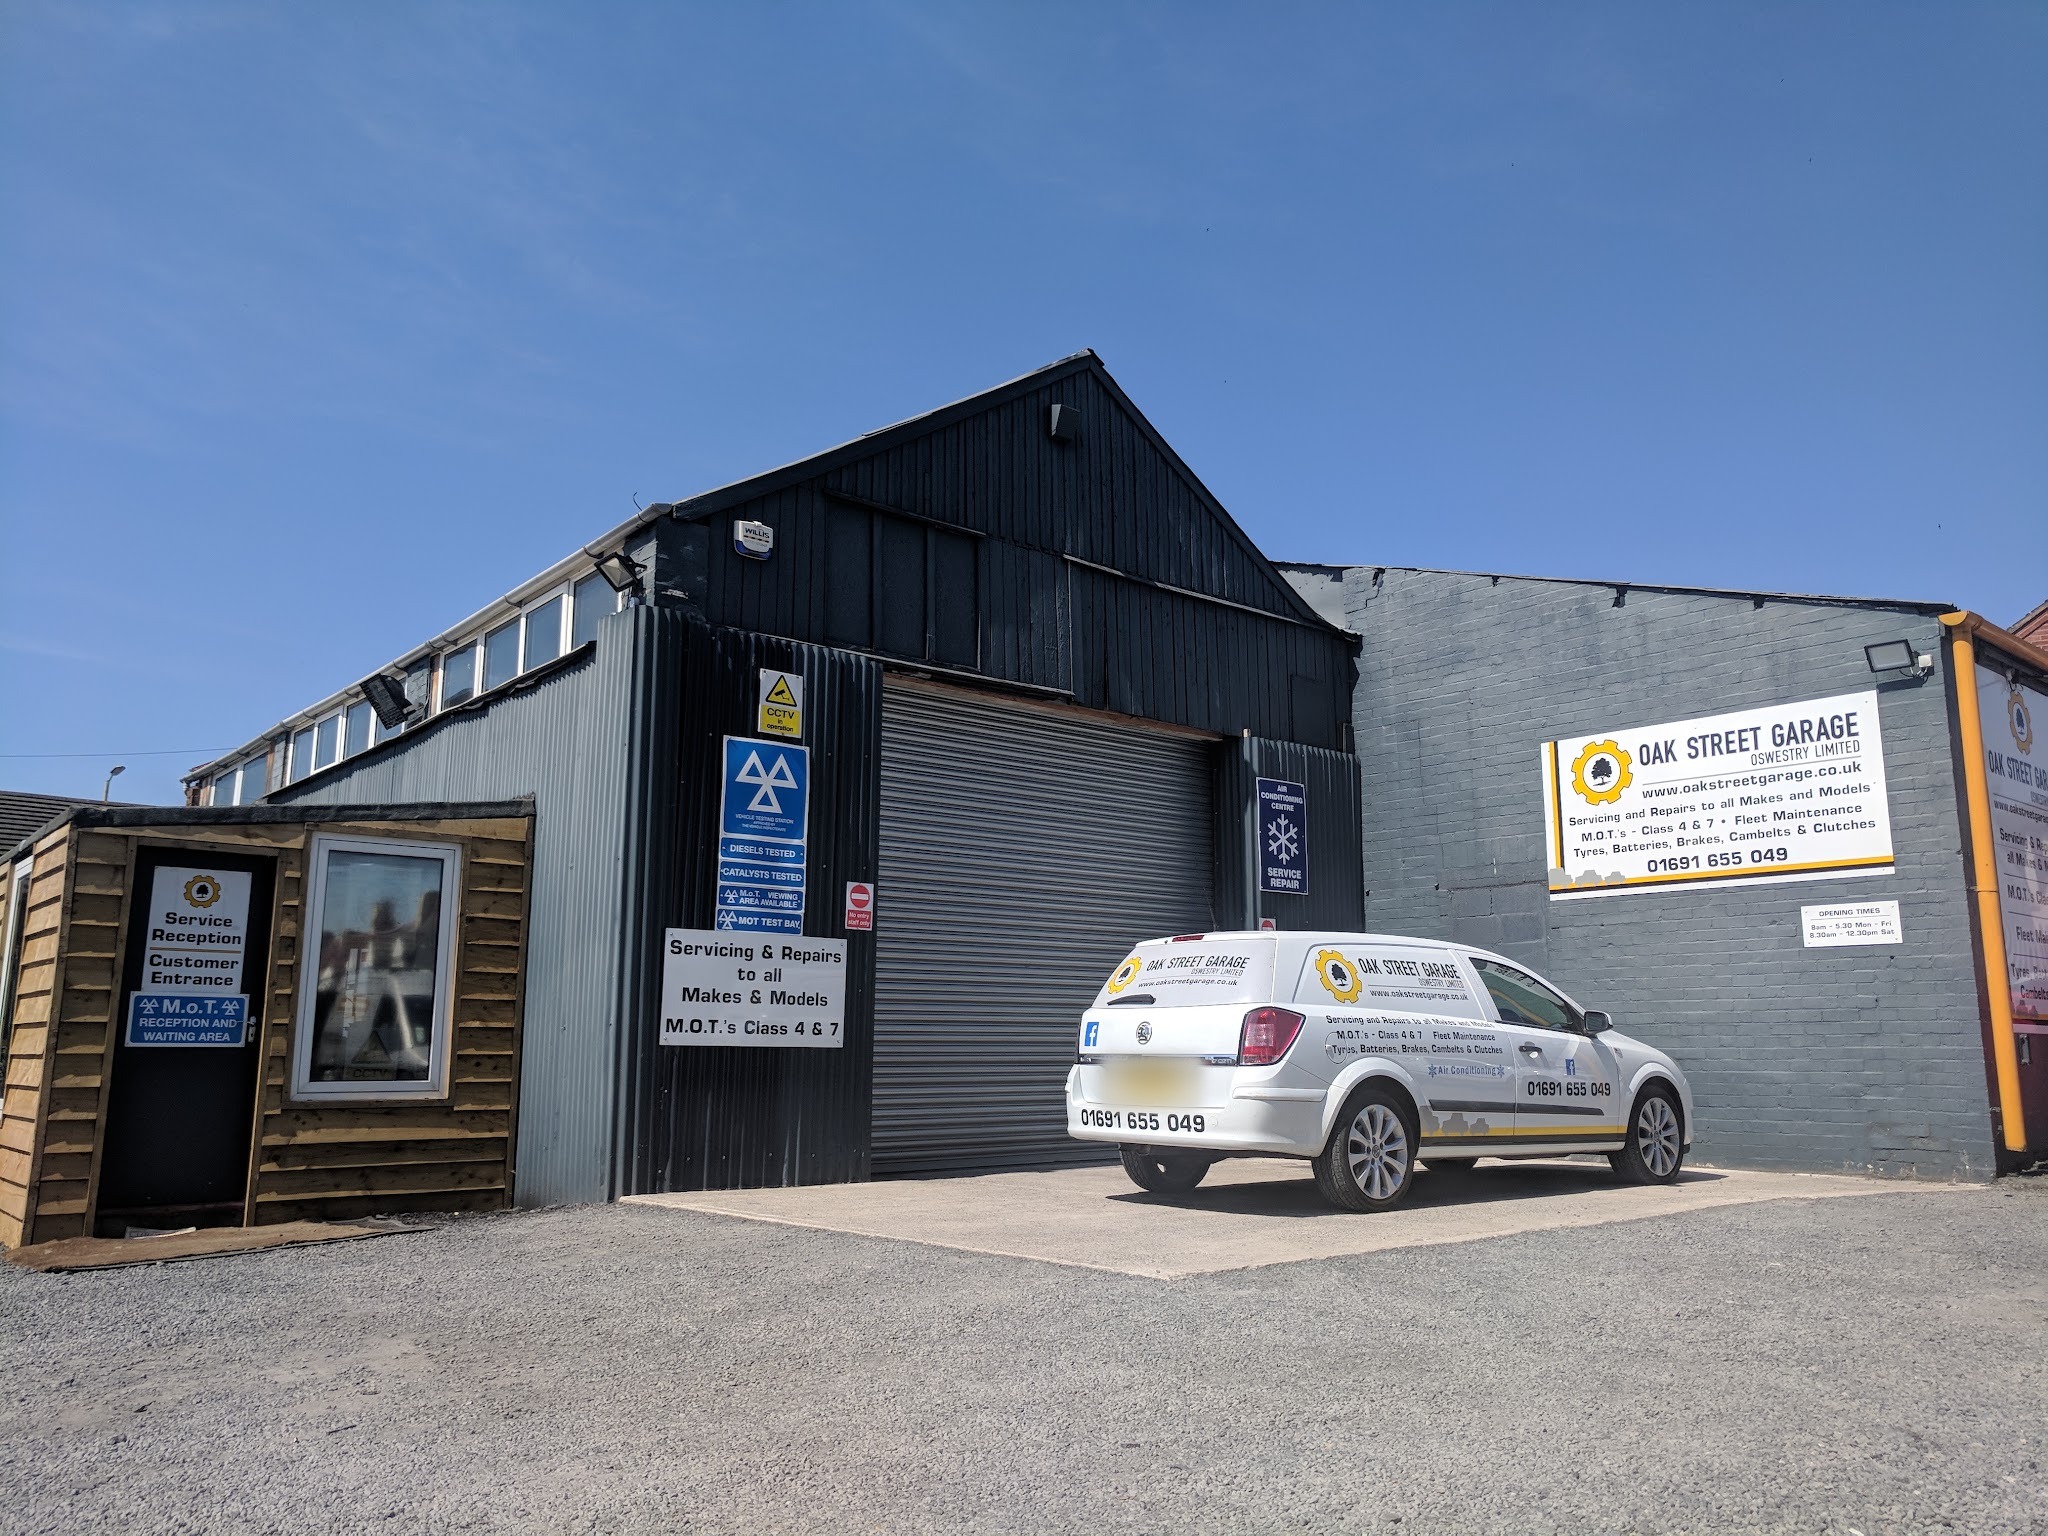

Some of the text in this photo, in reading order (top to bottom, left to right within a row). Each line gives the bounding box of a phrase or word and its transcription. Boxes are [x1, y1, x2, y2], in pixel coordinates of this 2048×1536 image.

[745, 528, 770, 538] WILLIS
[767, 708, 794, 719] CCTV
[767, 724, 793, 732] operation
[1639, 712, 1860, 766] OAK STREET GARAGE
[1750, 740, 1861, 766] OSWESTRY LIMITED
[1989, 750, 2048, 791] OAK STREET GAR
[1642, 761, 1862, 799] www.oakstreetgarage.co.uk
[1261, 793, 1303, 804] CONDITIONING
[1569, 783, 1871, 826] Servicing and Repairs to all Makes and Models
[1271, 803, 1294, 812] CENTRE
[1581, 829, 1626, 842] M.O.T.'s
[1642, 825, 1674, 835] Class
[1678, 822, 1686, 831] 4
[1693, 820, 1701, 830] &
[1706, 819, 1714, 828] 7
[1735, 814, 1767, 825] Fleet
[1773, 805, 1862, 821] Maintenance
[1574, 820, 1876, 859] Tyres, Batteries, Brakes, Cambelts & Clutches
[730, 844, 796, 858] DIESELS TESTED
[1648, 848, 1788, 873] 01691 655 049
[723, 868, 802, 881] CATALYSTS TESTED
[1267, 867, 1302, 879] SERVICE
[1270, 878, 1299, 889] REPAIR
[740, 889, 798, 900] M.o.T. VIEWING
[739, 897, 798, 908] AREA AVAILABLE
[165, 912, 232, 927] Service
[1819, 909, 1853, 917] OPENING
[739, 917, 800, 928] MOT TEST BAY
[152, 928, 242, 946] Reception
[2016, 926, 2034, 942] Fleet
[670, 939, 842, 964] Servicing & Repairs
[149, 954, 239, 969] Customer
[1146, 956, 1250, 971] OAK STREET GARAGE
[1358, 958, 1461, 979] OAK STREET GARAGE
[151, 971, 233, 986] Entrance
[737, 968, 782, 982] to all
[1221, 968, 1243, 976] LIMITED
[1139, 979, 1238, 988] www.oakstreetgarage.co.uk
[1419, 978, 1465, 988] OSWESTRY LIMITED
[682, 987, 828, 1006] Makes & Models
[1369, 989, 1469, 1001] www.oakstreetgarage.co.uk
[162, 999, 219, 1014] M.o.T.
[139, 1018, 237, 1028] RECEPTION AND
[665, 1018, 839, 1036] M.O.T.'s Class 4 & 7
[1326, 1015, 1364, 1025] Servicing
[1366, 1016, 1380, 1024] and
[1381, 1016, 1411, 1025] Repairs
[144, 1031, 230, 1042] WAITING AREA
[1378, 1030, 1399, 1039] Class
[1402, 1031, 1407, 1039] 4
[1410, 1031, 1415, 1039] &
[1417, 1031, 1422, 1039] 7
[1433, 1032, 1451, 1040] Fleet
[1453, 1032, 1495, 1040] Maintenance
[1332, 1044, 1503, 1055] Tyres, Batteries, Brakes, Cambelts & Clutches
[1438, 1066, 1496, 1076] Air Conditioning
[1528, 1081, 1610, 1096] 01691 655 049
[1081, 1109, 1205, 1132] 01691 655 049
